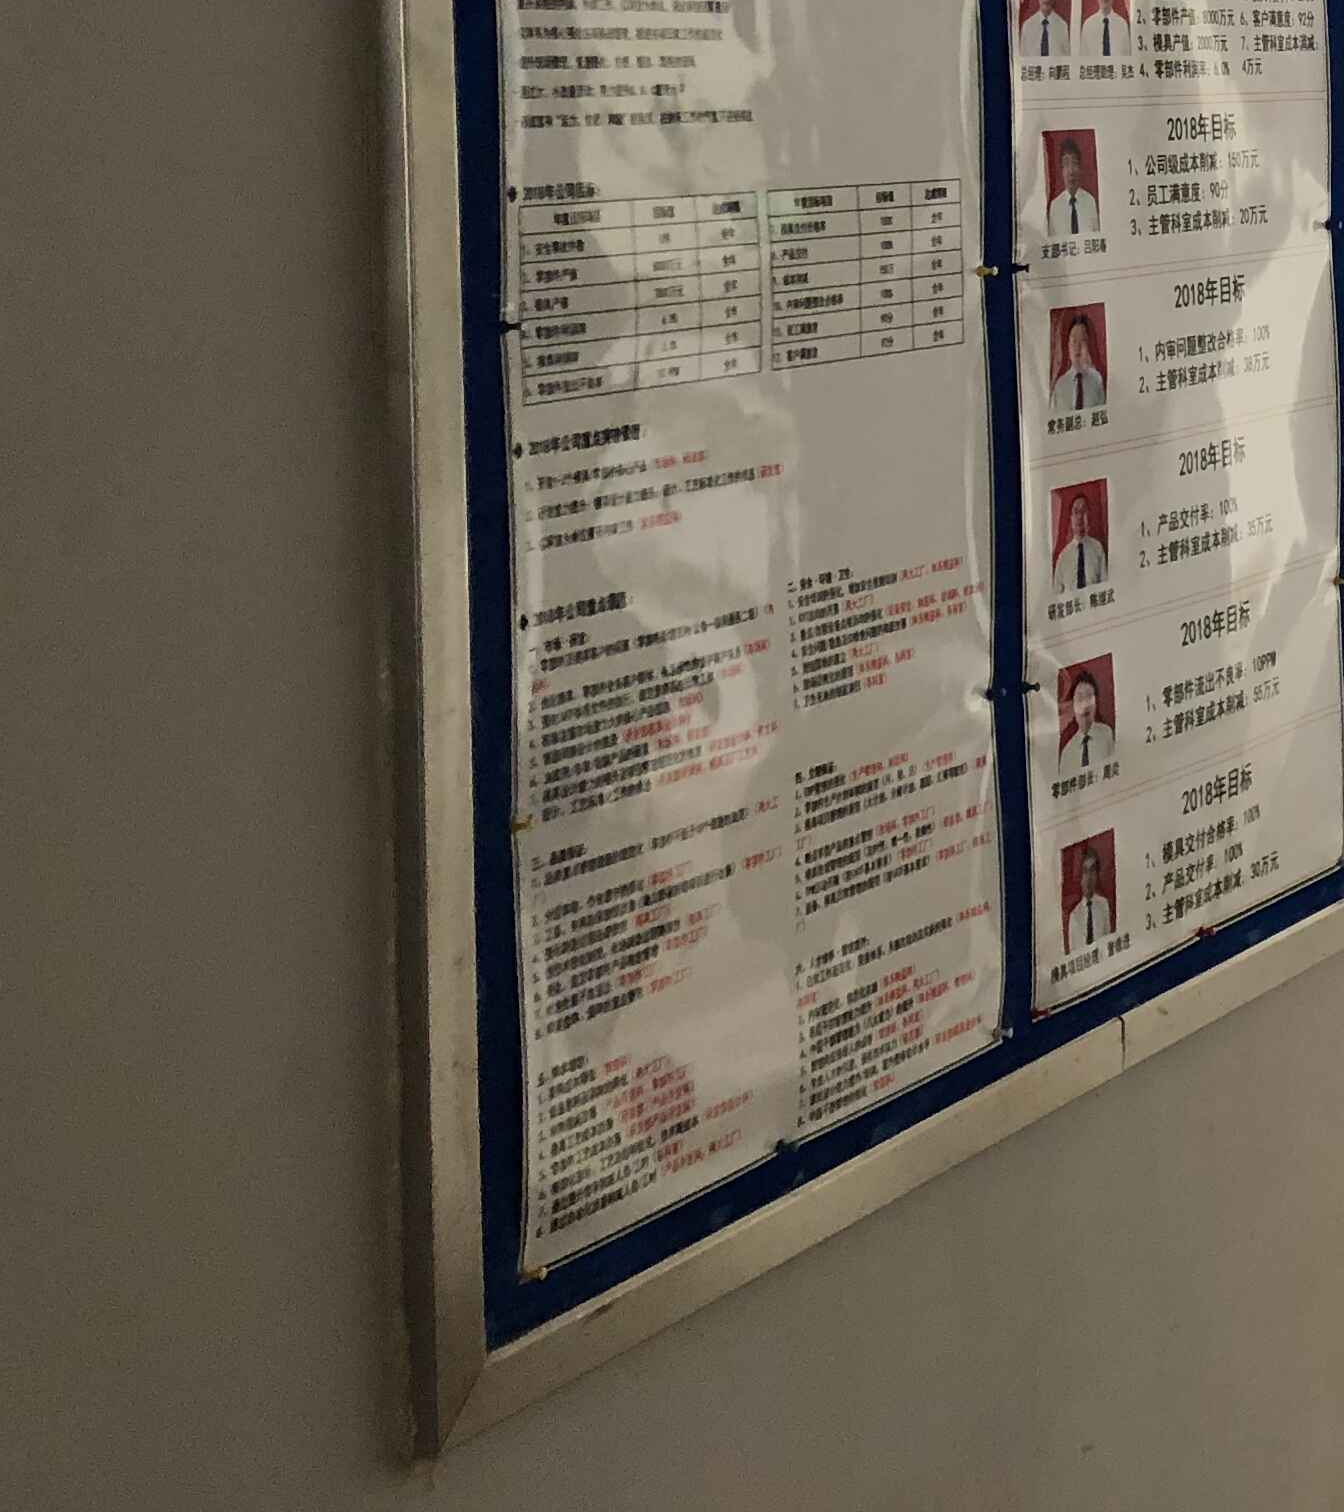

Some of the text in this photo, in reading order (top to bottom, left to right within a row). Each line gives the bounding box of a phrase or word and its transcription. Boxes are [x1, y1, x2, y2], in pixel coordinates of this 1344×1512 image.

[1167, 112, 1236, 143] 2018年目标
[1174, 274, 1246, 309] 2018年目标
[1179, 436, 1246, 476] 2018年目标
[1181, 600, 1251, 647] 2018年目标
[1182, 762, 1253, 816] 2018年目标
